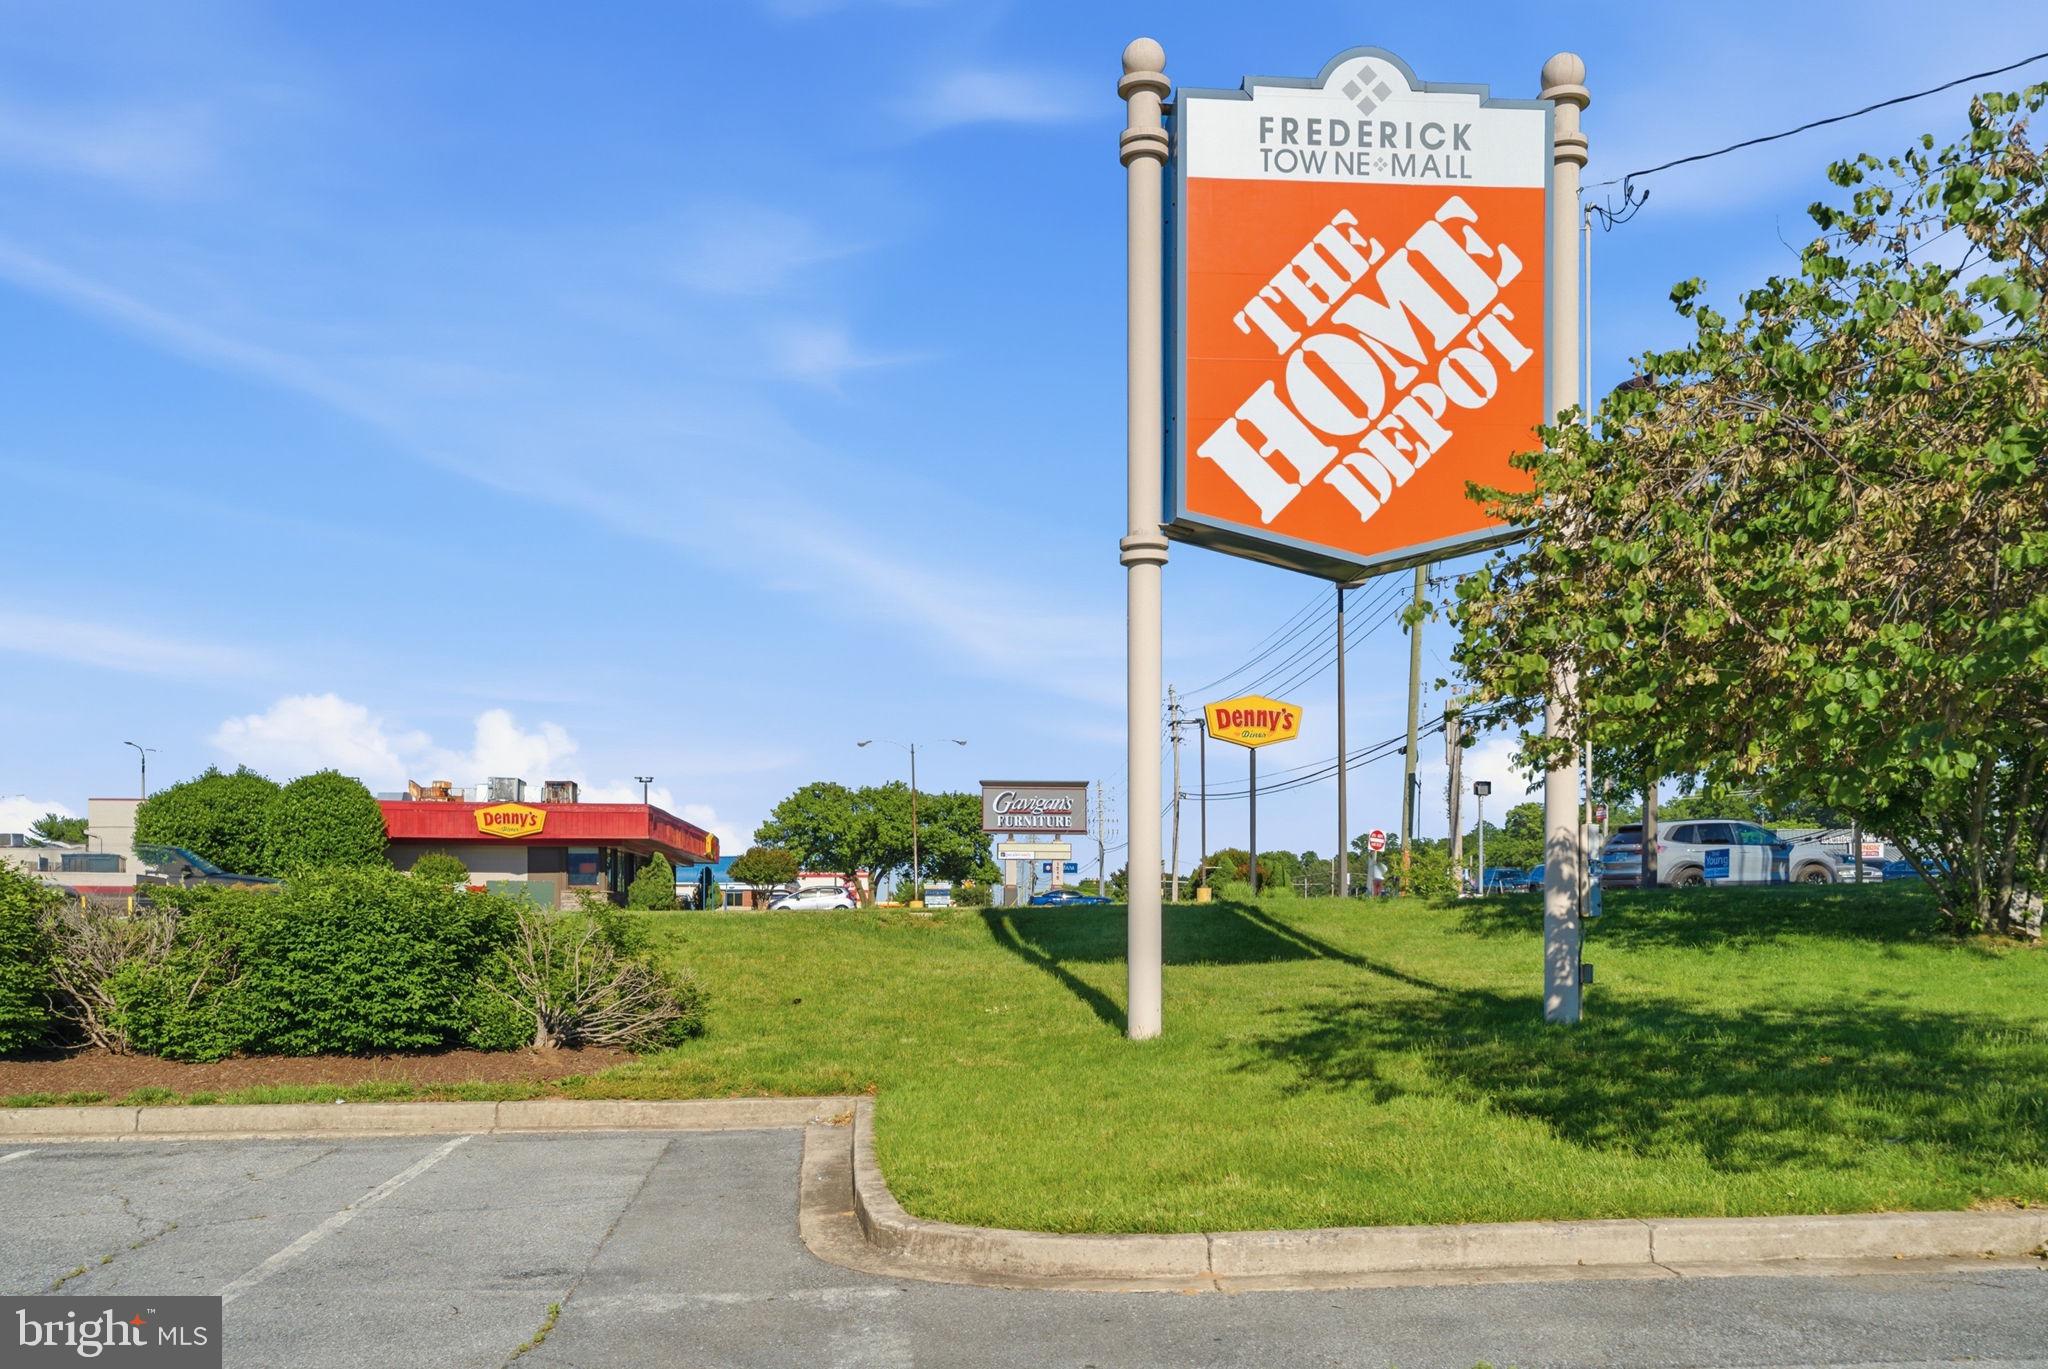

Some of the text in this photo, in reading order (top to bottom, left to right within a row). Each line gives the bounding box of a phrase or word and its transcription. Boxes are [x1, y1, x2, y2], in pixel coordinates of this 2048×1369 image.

[1259, 116, 1473, 151] FREDERICK
[1260, 148, 1473, 180] TOWNE MALL
[1233, 208, 1386, 356] THE
[1196, 195, 1523, 525] HOME
[1323, 302, 1535, 523] DEPOT
[1215, 707, 1294, 732] Denny's
[992, 790, 1074, 816] Gavigan's
[483, 811, 538, 828] Denny's
[997, 815, 1073, 828] FURNITURE
